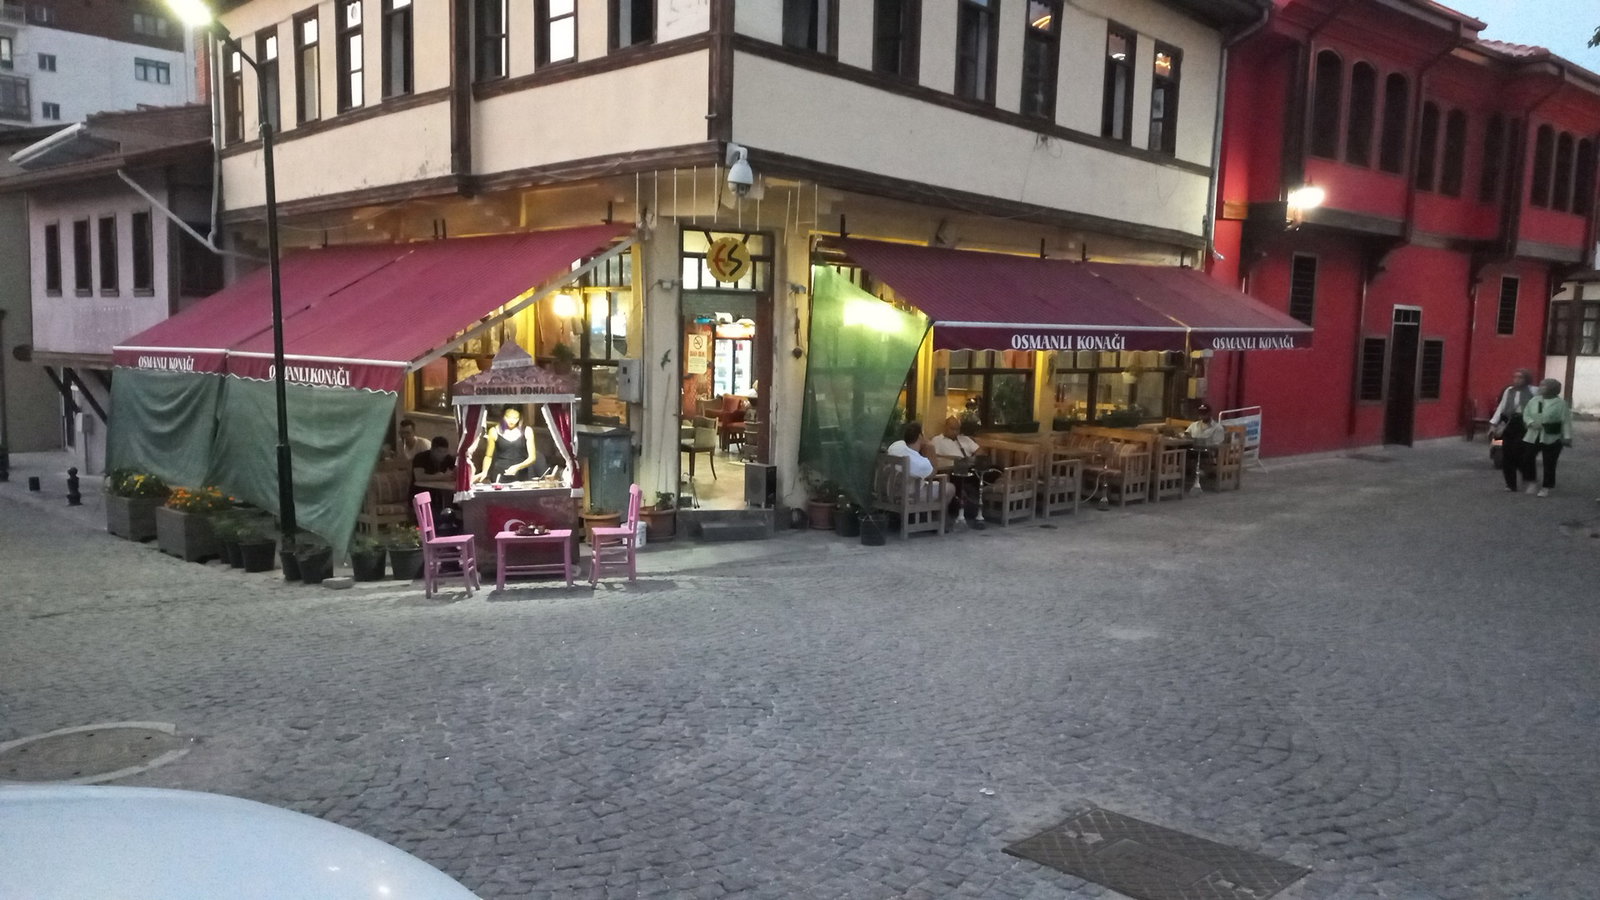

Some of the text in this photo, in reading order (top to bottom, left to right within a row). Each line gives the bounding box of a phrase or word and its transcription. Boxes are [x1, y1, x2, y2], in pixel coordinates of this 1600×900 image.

[713, 243, 743, 277] ES
[1011, 333, 1126, 350] OSMANLI KONAĞI
[1212, 334, 1295, 350] OSMANLI KONAĞI
[138, 355, 195, 371] OSMANLI KONAĞI
[268, 364, 350, 386] OANLI KONAĞI
[475, 386, 518, 396] OSMANLI
